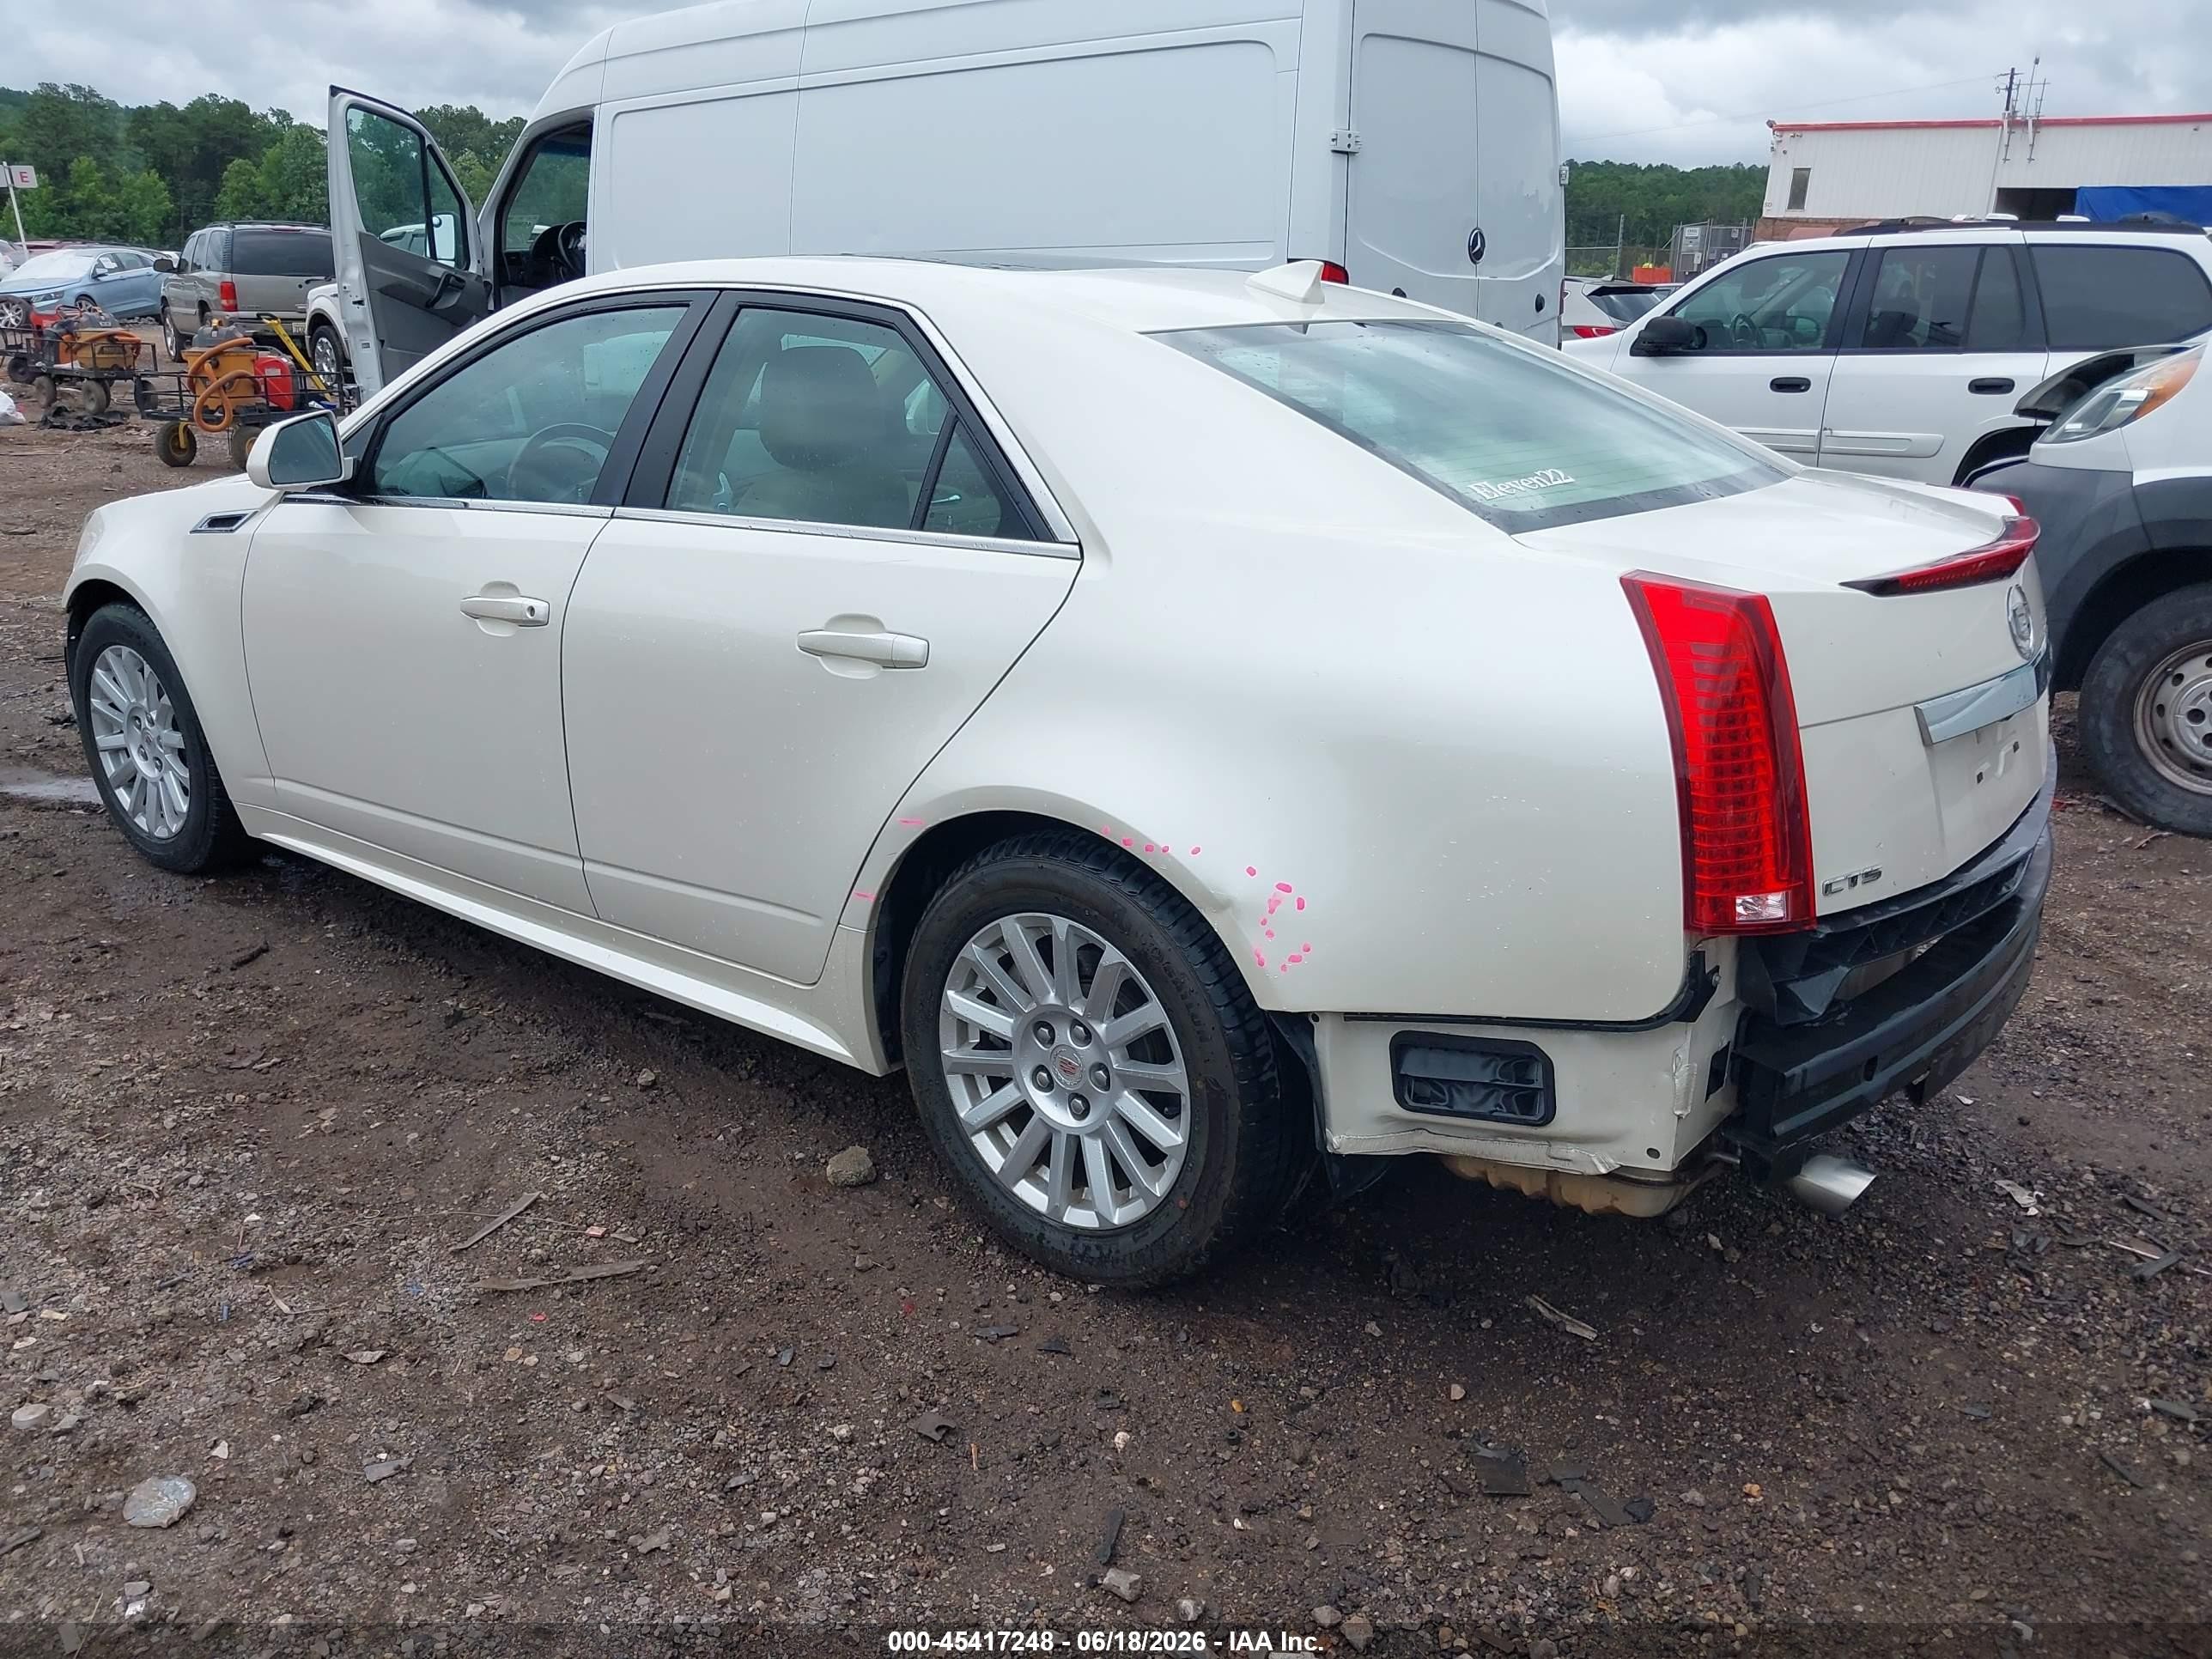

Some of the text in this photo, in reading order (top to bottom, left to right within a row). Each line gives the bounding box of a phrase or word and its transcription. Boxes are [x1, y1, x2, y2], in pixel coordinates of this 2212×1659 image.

[19, 171, 30, 183] E
[1468, 468, 1575, 500] Eleven22
[1821, 864, 1883, 896] CTS
